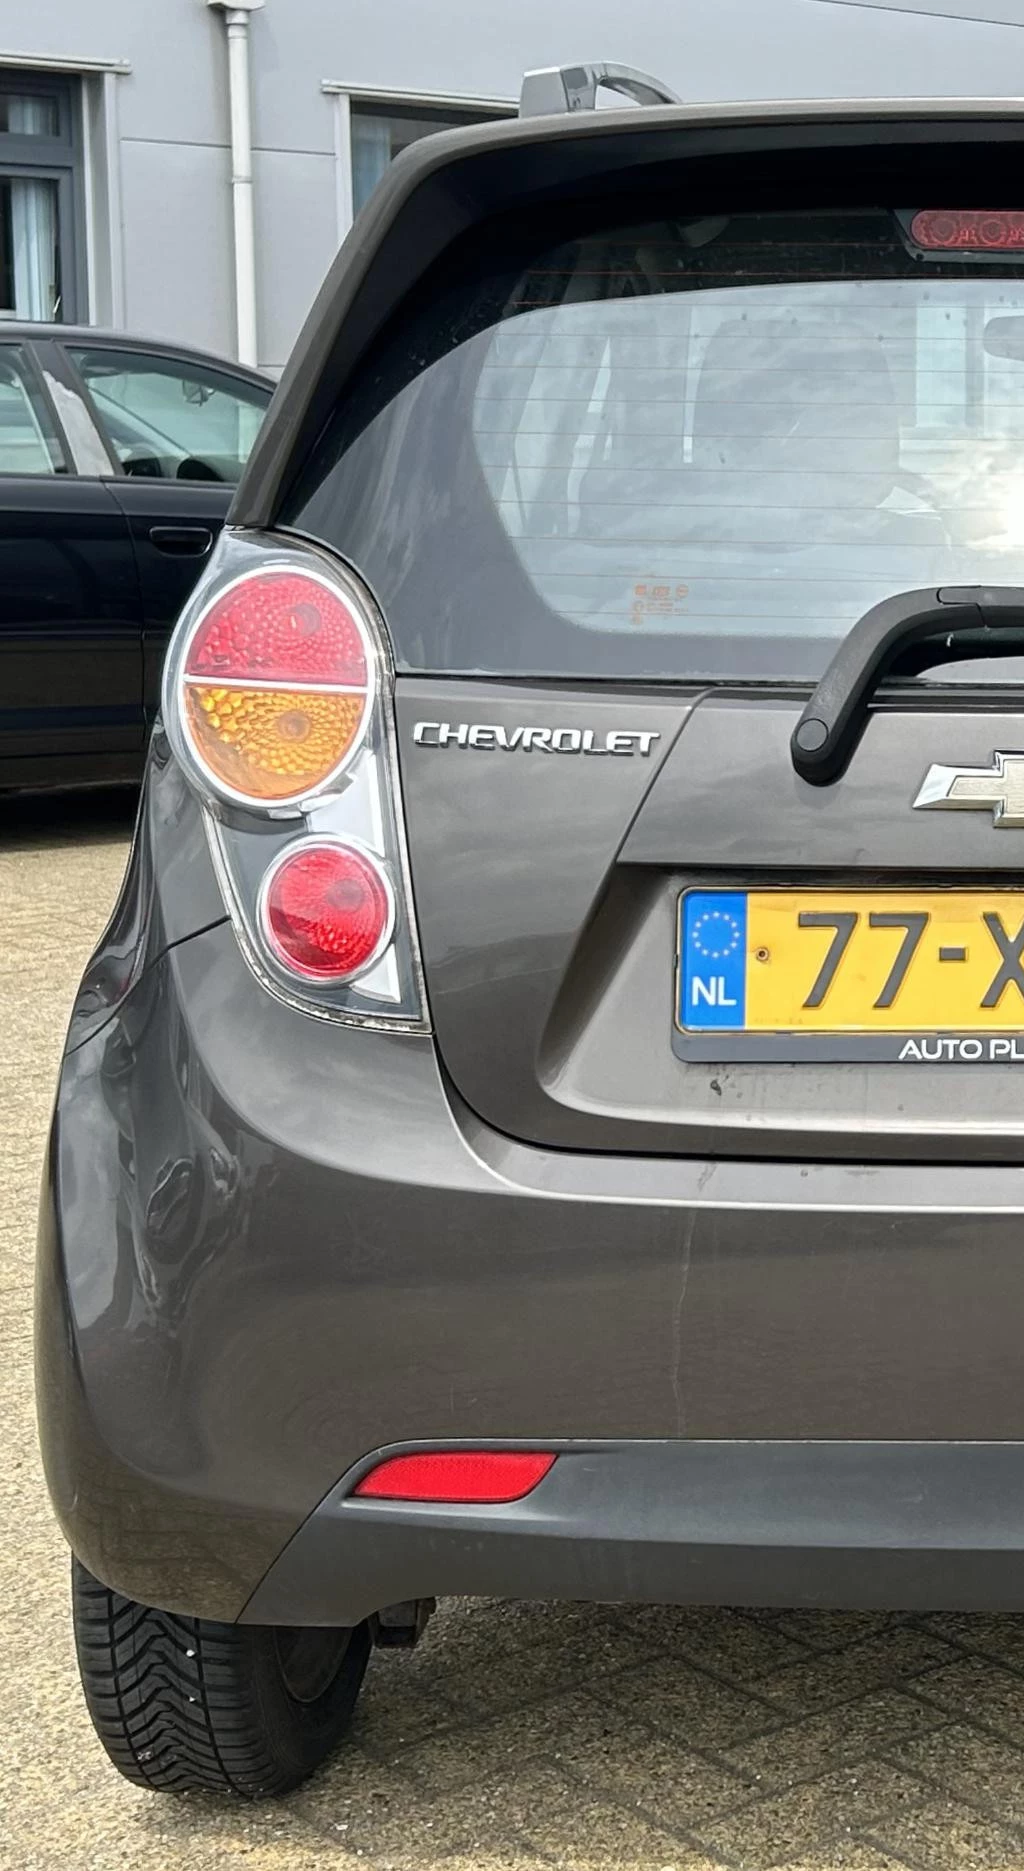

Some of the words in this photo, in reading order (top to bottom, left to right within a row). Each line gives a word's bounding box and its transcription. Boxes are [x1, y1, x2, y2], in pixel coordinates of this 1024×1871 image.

[413, 721, 661, 757] CHEVROLET
[692, 975, 737, 1006] NL
[898, 1039, 984, 1060] AUTO
